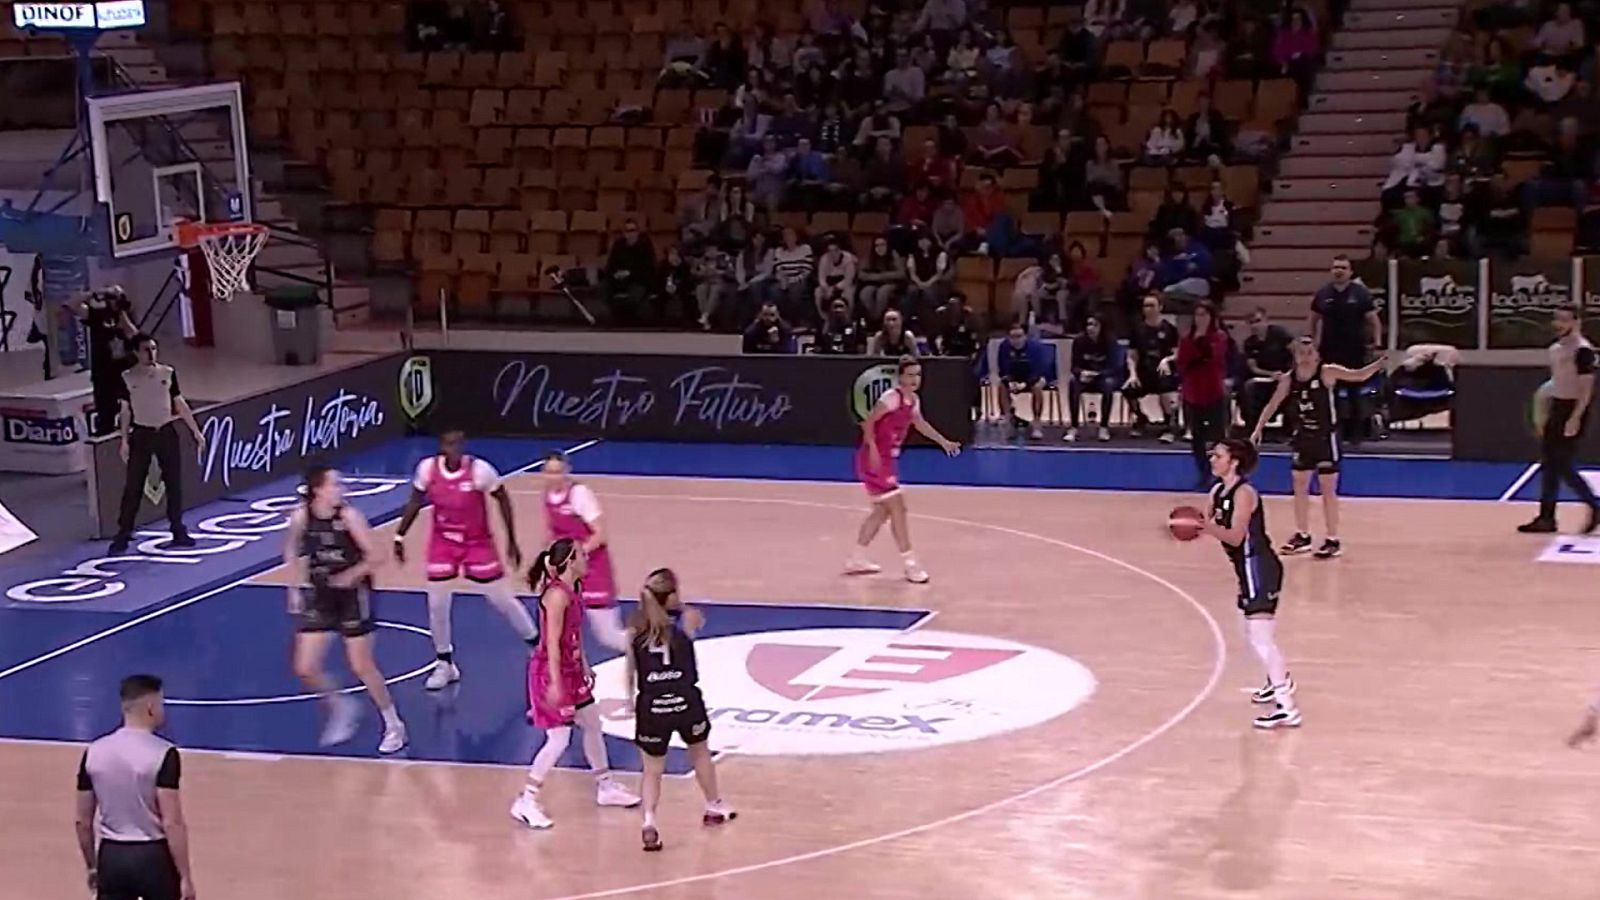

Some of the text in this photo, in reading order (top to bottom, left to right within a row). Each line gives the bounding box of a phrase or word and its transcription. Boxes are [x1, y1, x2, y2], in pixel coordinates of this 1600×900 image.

[493, 361, 654, 429] Nuestro
[670, 367, 792, 429] Futuro
[9, 419, 73, 441] Diario
[202, 396, 295, 487] Nuestra
